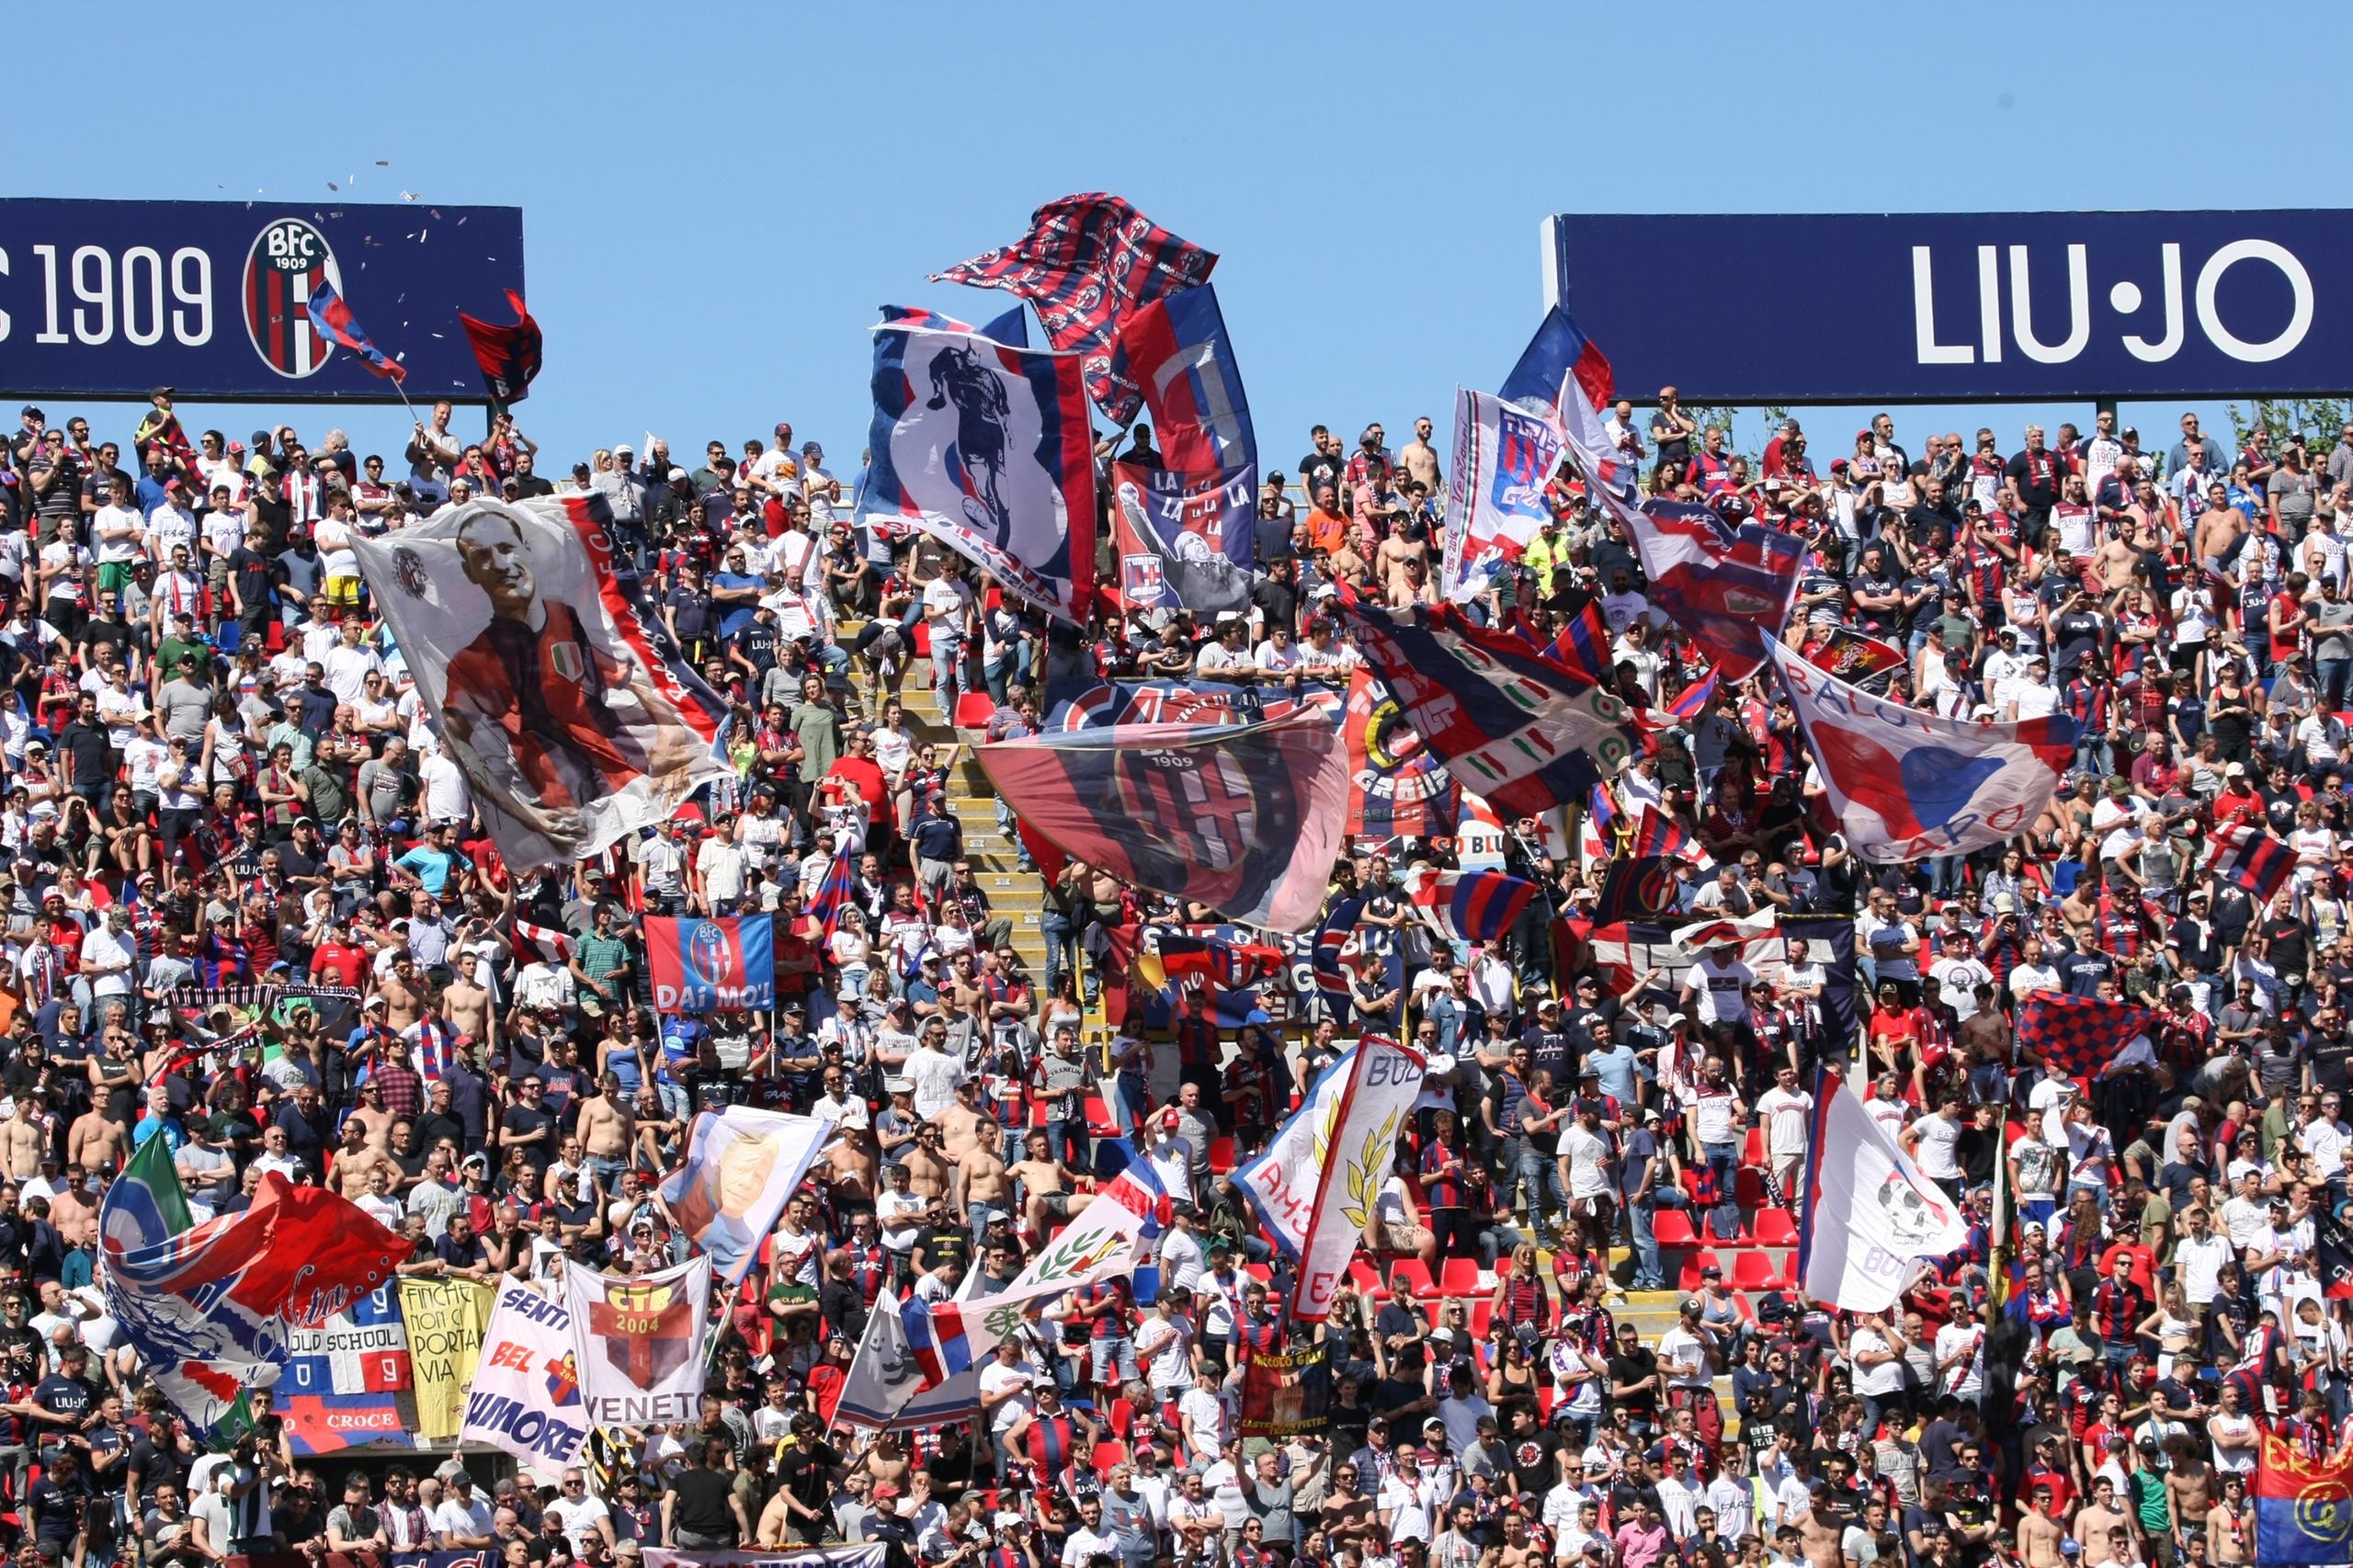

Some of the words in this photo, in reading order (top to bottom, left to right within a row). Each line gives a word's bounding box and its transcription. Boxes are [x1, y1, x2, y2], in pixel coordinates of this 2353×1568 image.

[268, 225, 314, 256] BFC
[276, 257, 307, 269] 1909
[34, 244, 213, 346] 1909
[1504, 413, 1561, 453] TURIS
[1154, 472, 1178, 492] LA
[1183, 489, 1198, 501] LA
[1226, 483, 1251, 508] LA
[1161, 497, 1185, 523] LA
[1204, 499, 1218, 513] LA
[1206, 519, 1222, 536] LA
[751, 640, 769, 650] LIU·J
[1101, 654, 1131, 665] FAAC
[1151, 756, 1194, 767] 1909
[135, 919, 166, 932] FAAC
[699, 927, 718, 938] BFC
[2107, 924, 2140, 933] FAAC
[1340, 930, 1394, 957] BLU
[1051, 1067, 1082, 1076] FRANKLIN
[607, 1286, 672, 1312] CTB
[410, 1311, 447, 1333] NON
[616, 1314, 660, 1333] 2004
[326, 1328, 399, 1352] SCHOOL
[415, 1328, 486, 1358] PORTA
[488, 1340, 537, 1374] BEL
[417, 1358, 457, 1384] VIA
[54, 1395, 89, 1408] LIU·JO
[326, 1412, 395, 1428] CROCE
[466, 1391, 587, 1464] UMORE
[1721, 1501, 1749, 1510] FAAC
